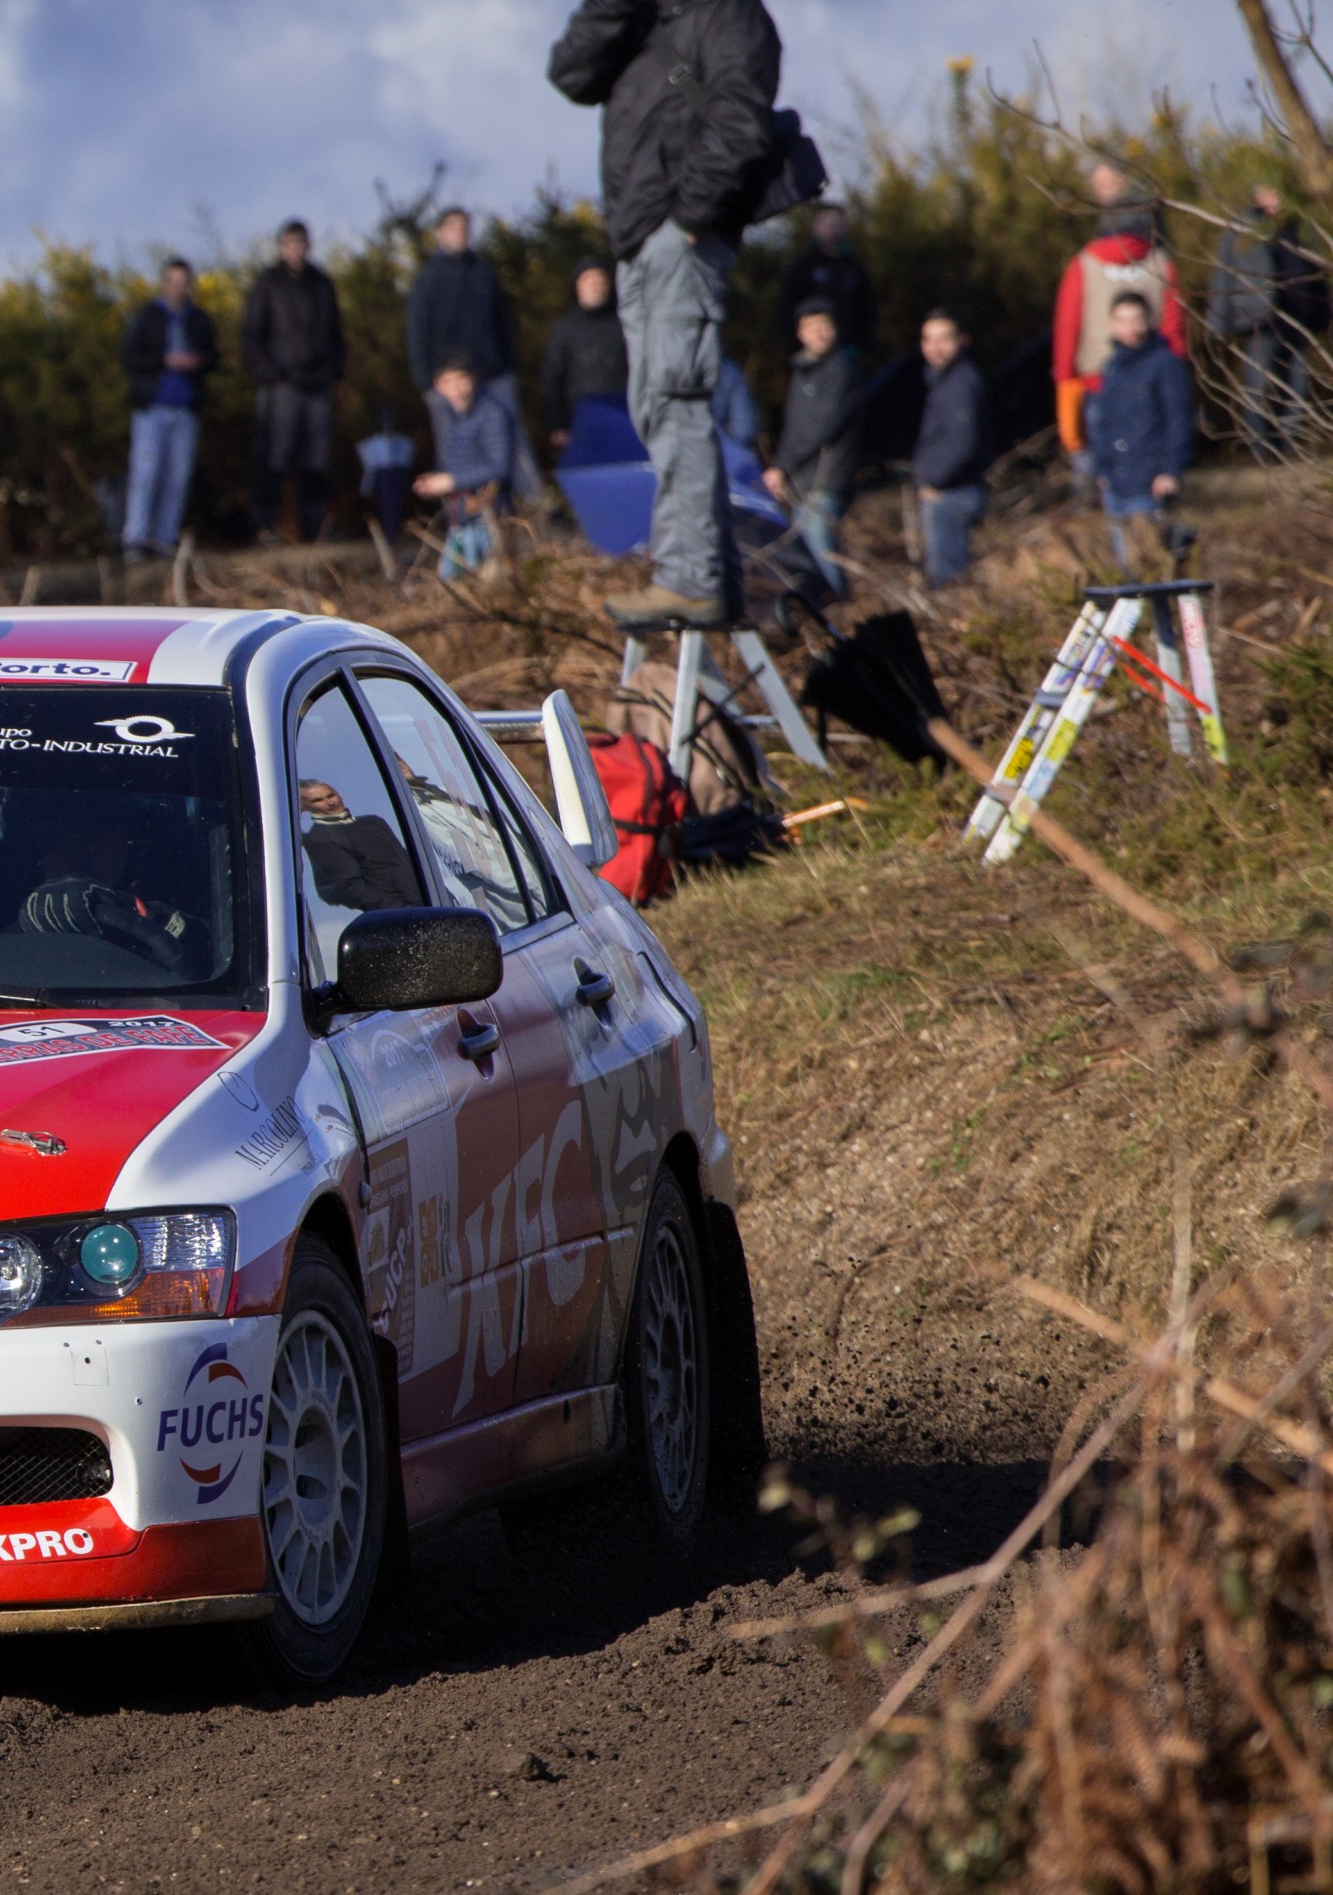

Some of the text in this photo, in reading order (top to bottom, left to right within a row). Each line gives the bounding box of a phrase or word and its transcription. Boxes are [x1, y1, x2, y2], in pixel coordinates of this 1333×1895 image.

[17, 1026, 66, 1037] 51
[75, 1033, 133, 1049] DE
[125, 1025, 209, 1046] FAFE
[107, 1020, 175, 1028] 2017
[234, 1095, 307, 1171] MARCOLINO
[451, 1099, 586, 1420] KFC
[157, 1393, 264, 1452] FUCHS
